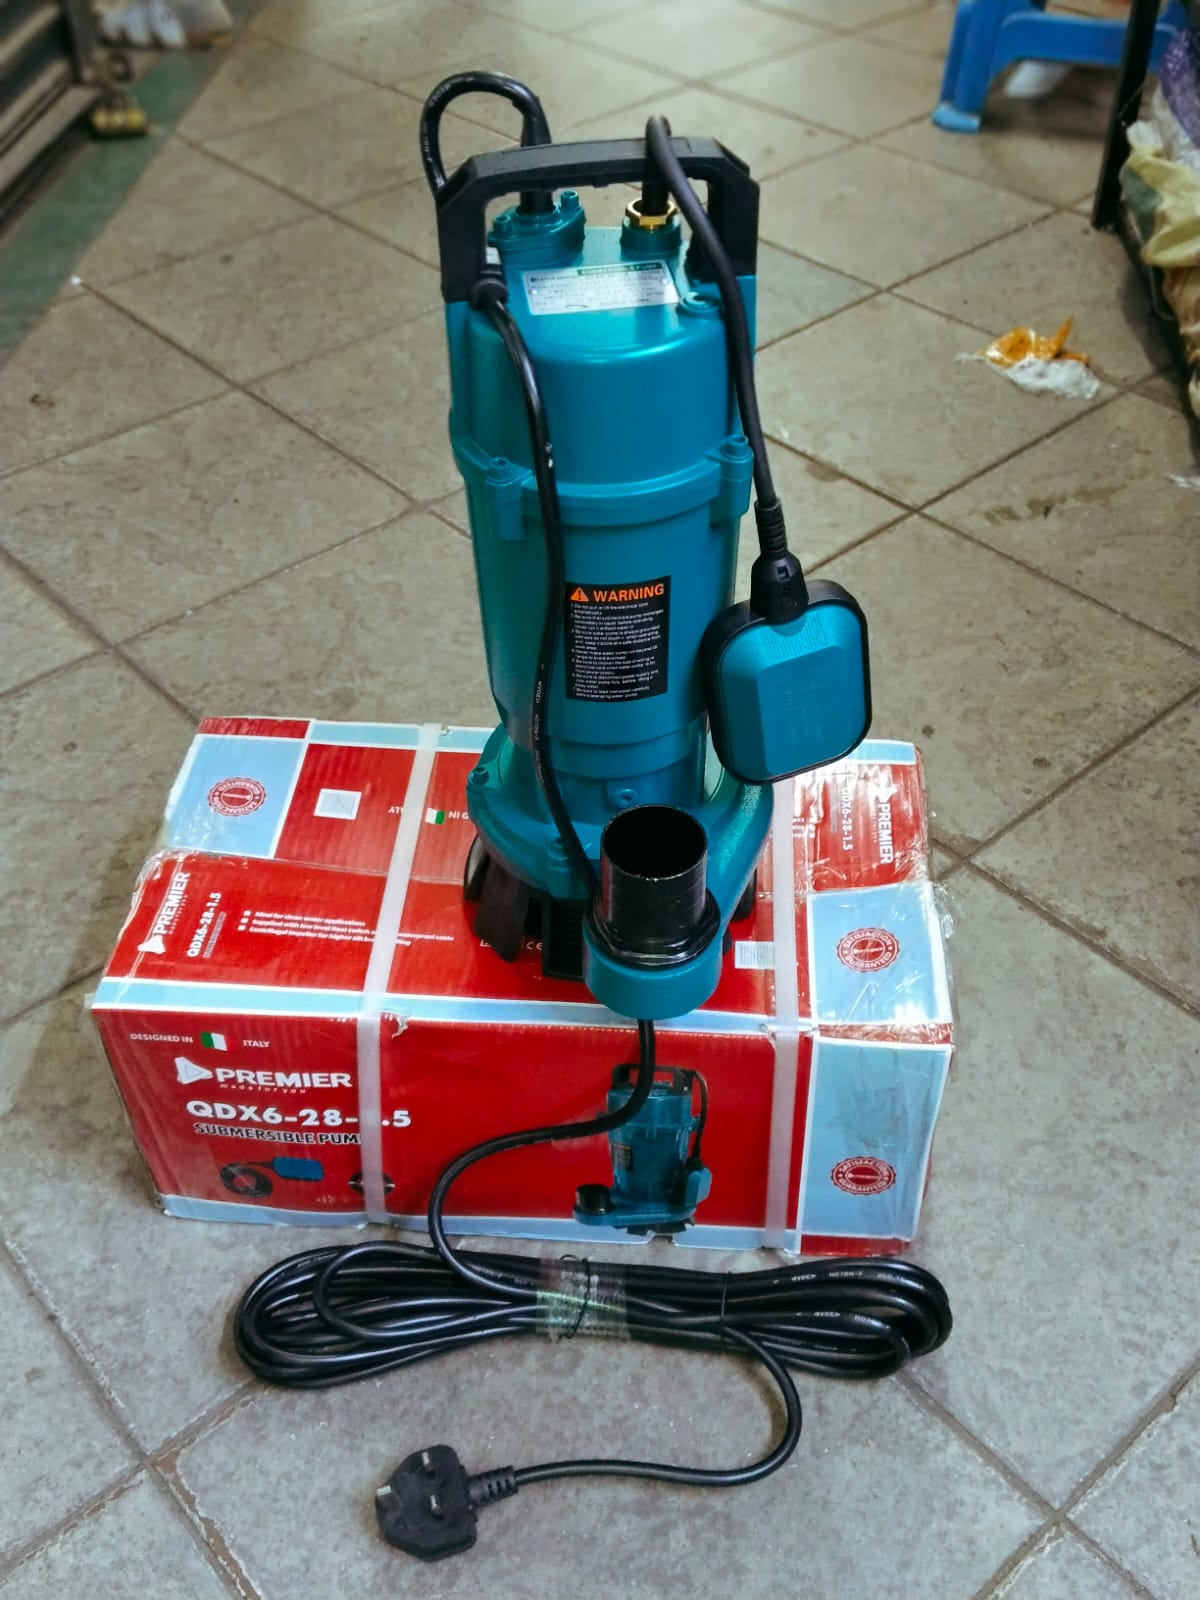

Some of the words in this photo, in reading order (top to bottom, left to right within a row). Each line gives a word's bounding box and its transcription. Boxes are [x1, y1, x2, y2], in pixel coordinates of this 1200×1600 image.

[593, 583, 664, 602] WARNING
[878, 803, 894, 864] PREMIER
[152, 871, 191, 935] PREMIER
[186, 892, 221, 957] QDX6-28-1.5
[130, 1033, 180, 1042] DESIGNED
[243, 1039, 270, 1048] ITALY
[215, 1068, 353, 1088] PREMIER
[186, 1100, 412, 1128] QDX6-28-.5
[193, 1122, 317, 1145] SUBMERSIBLE
[318, 1132, 362, 1145] PUM
